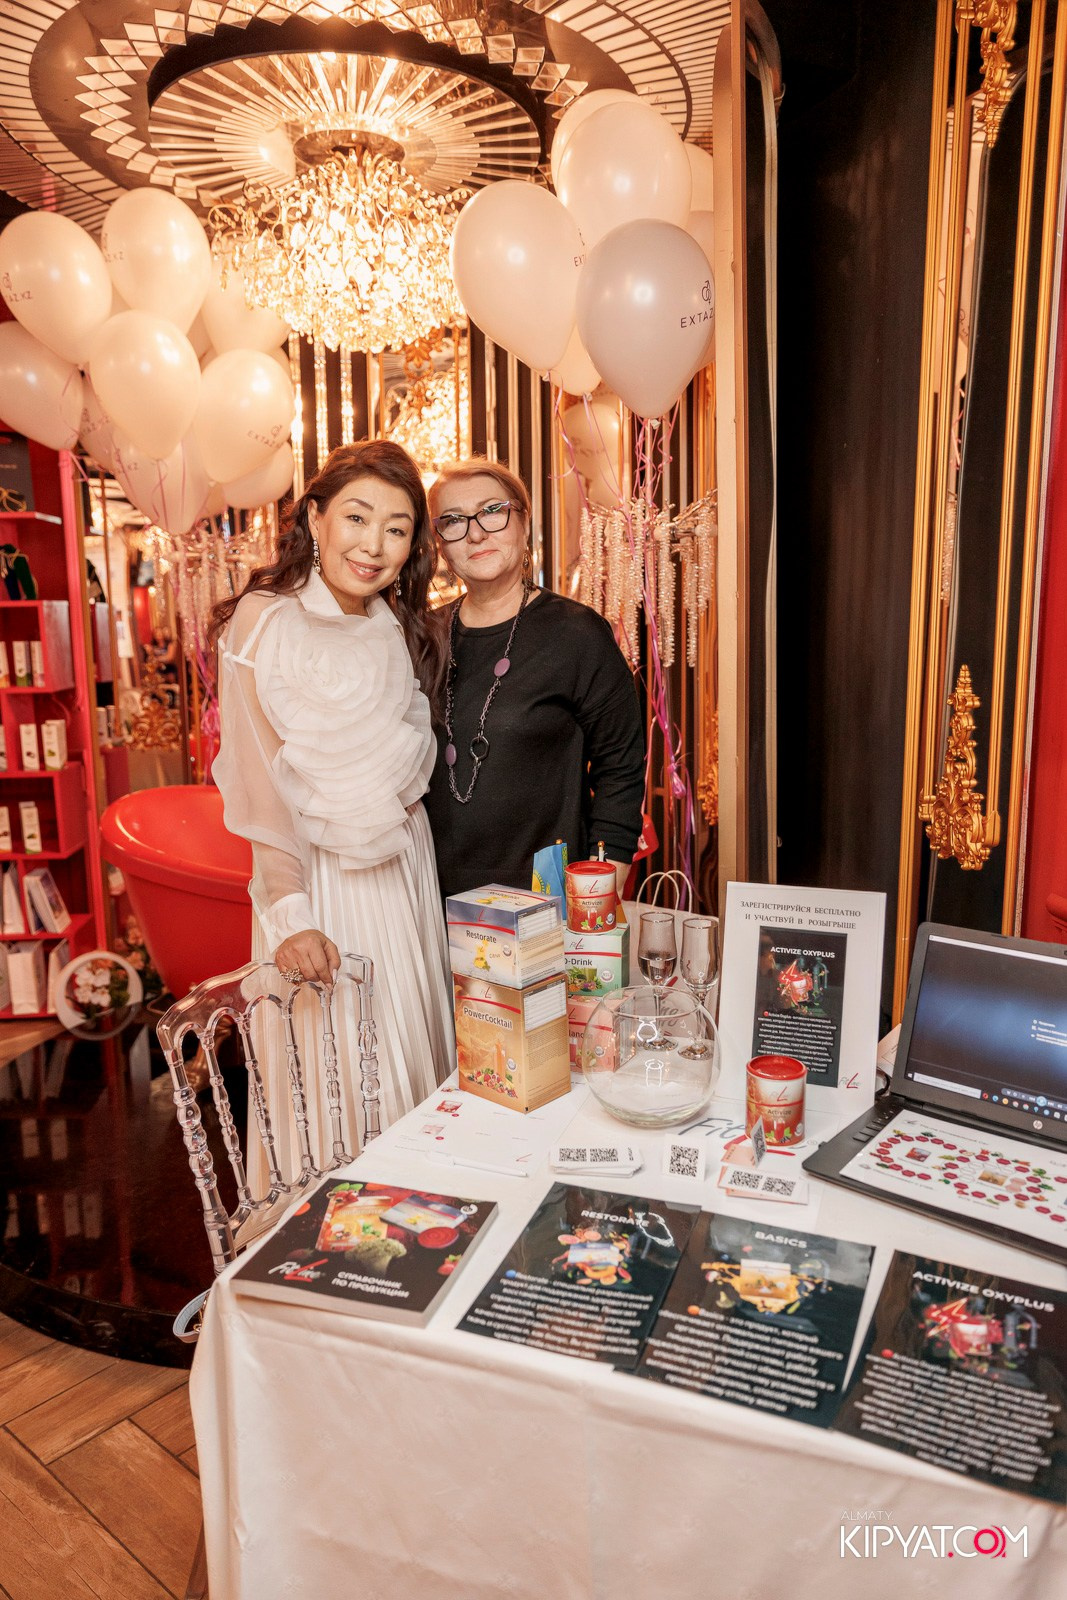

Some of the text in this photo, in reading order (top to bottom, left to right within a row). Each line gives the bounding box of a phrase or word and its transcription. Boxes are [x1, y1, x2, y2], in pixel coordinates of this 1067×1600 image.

[740, 900, 861, 917] ЗАРЕГИСТРИРУЙСЯ БЕСПЛАТНО
[754, 913, 794, 924] УЧАСТВУЙ
[808, 918, 856, 930] РОЗЫГРЫШЕ
[465, 930, 497, 943] Restorate
[770, 946, 835, 958] ACTIVIZE OXYPLUS
[463, 1007, 513, 1029] PowerCocktail
[581, 1209, 650, 1228] RESTORATE
[754, 1230, 808, 1249] BASICS
[331, 1278, 410, 1298] ПО ПРОДУКЦИИ
[337, 1271, 403, 1289] СПРАВОЧНИК
[912, 1270, 1055, 1313] ACTIVIZE OXYPLUS
